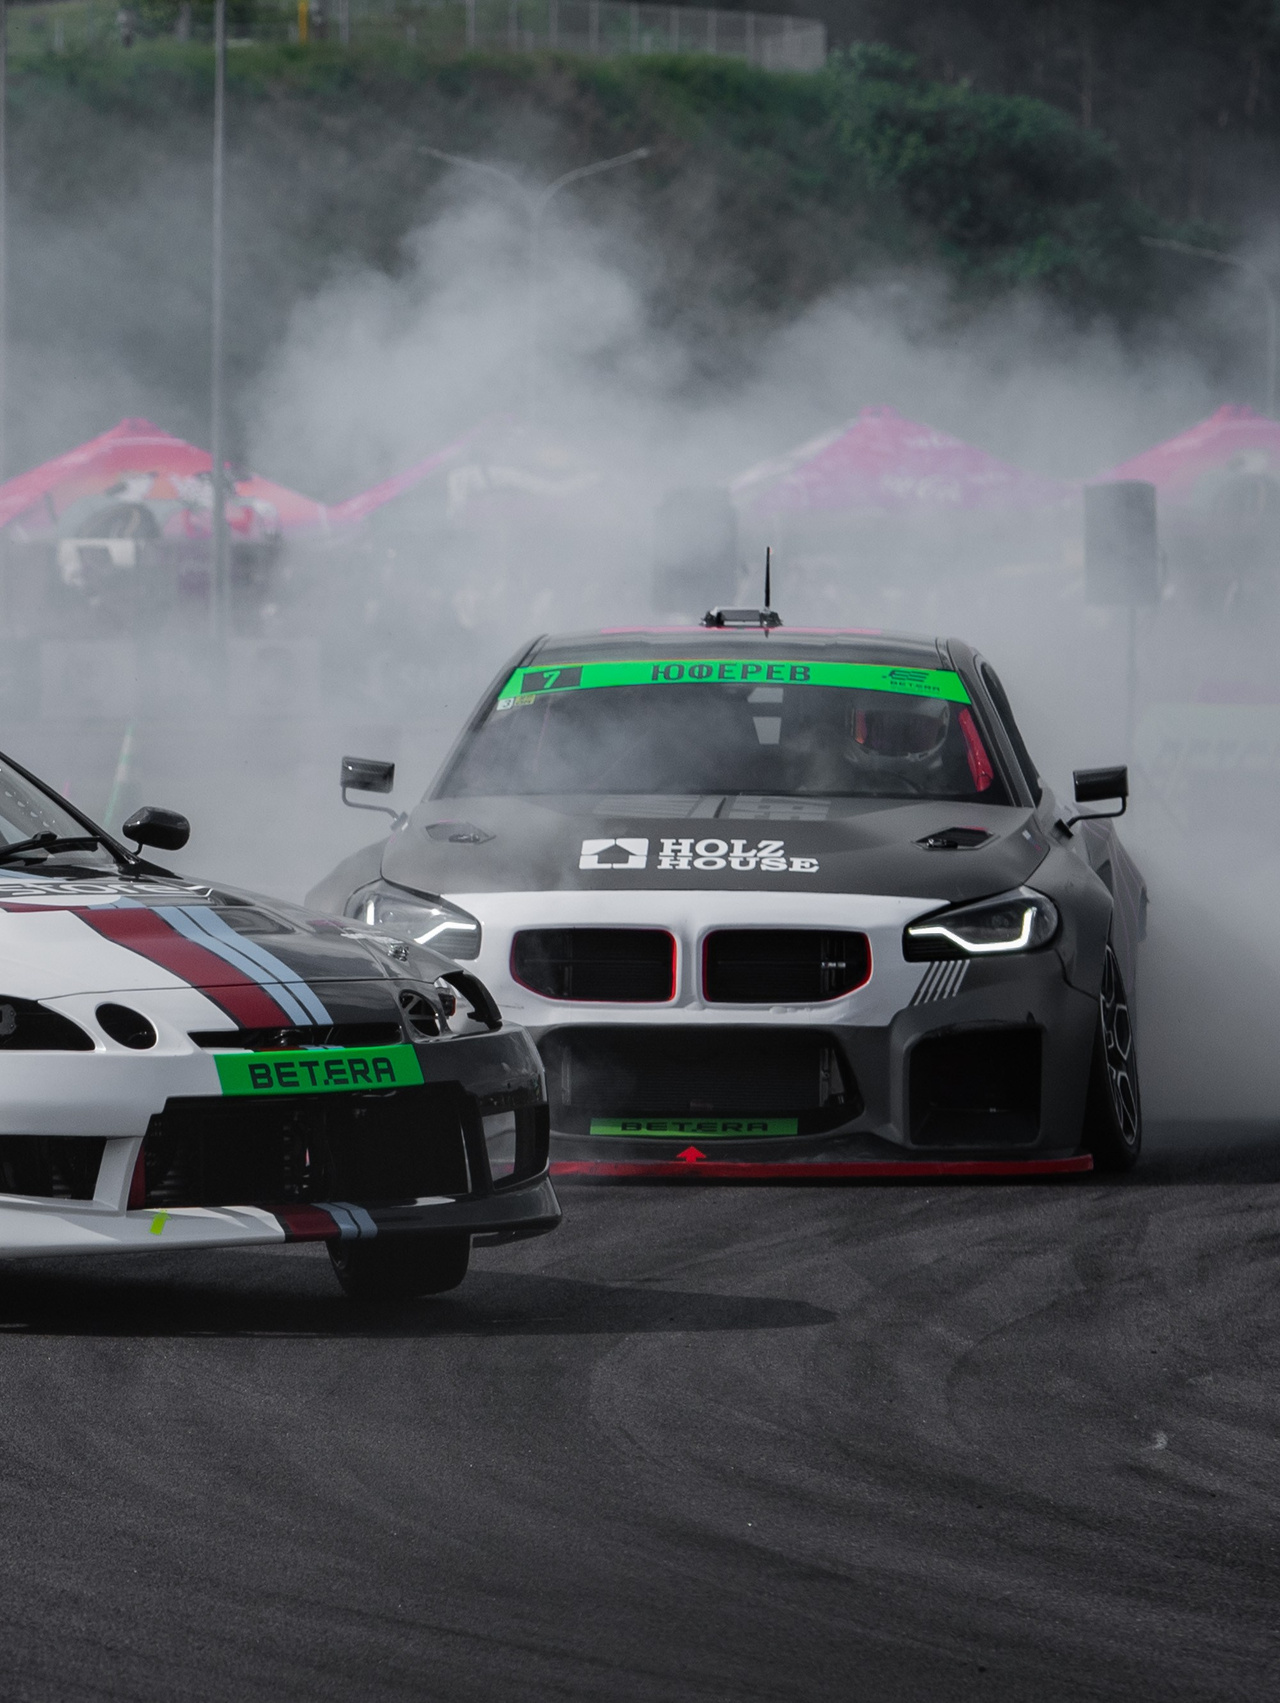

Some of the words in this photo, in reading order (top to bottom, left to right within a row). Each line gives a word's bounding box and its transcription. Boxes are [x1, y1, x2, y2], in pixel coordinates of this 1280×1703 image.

[543, 671, 561, 688] 7
[651, 663, 811, 682] ЮФЕРЕВ
[659, 838, 784, 857] HOLZ
[657, 856, 820, 873] HOUSE
[248, 1057, 396, 1089] BET.ERA
